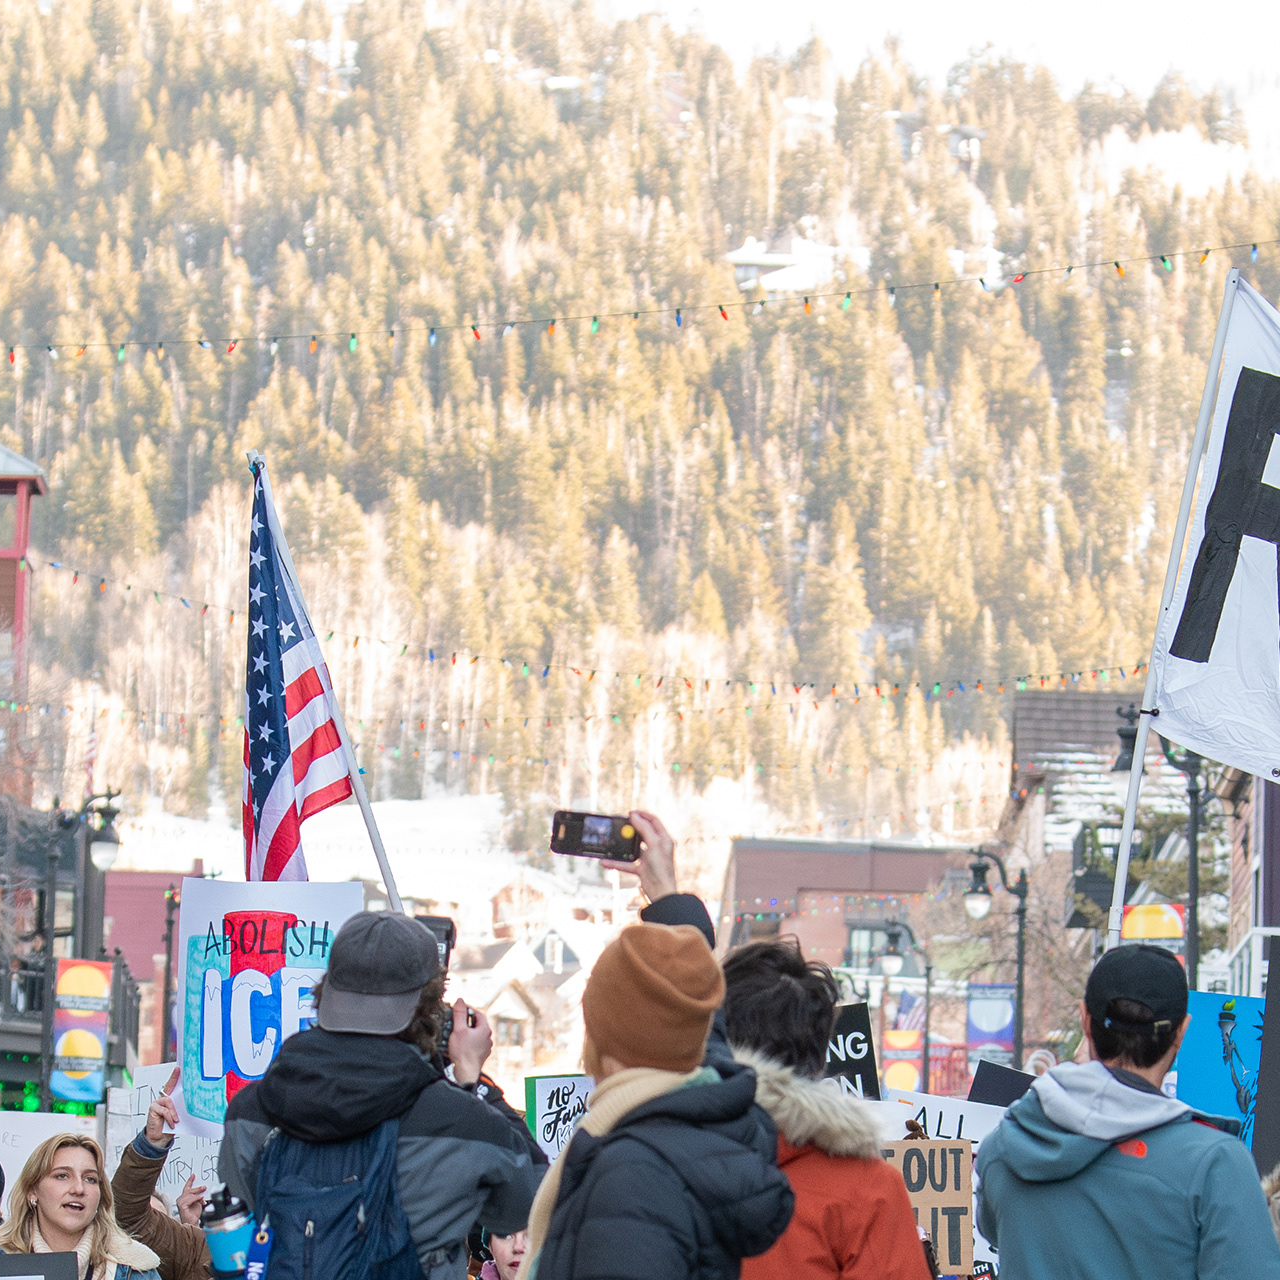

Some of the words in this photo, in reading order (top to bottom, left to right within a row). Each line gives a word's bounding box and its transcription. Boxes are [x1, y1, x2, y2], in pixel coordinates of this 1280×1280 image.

[204, 918, 329, 960] ABOLISH
[915, 1105, 979, 1145] ALL
[902, 1147, 964, 1193] OUT
[973, 1262, 990, 1276] ITH
